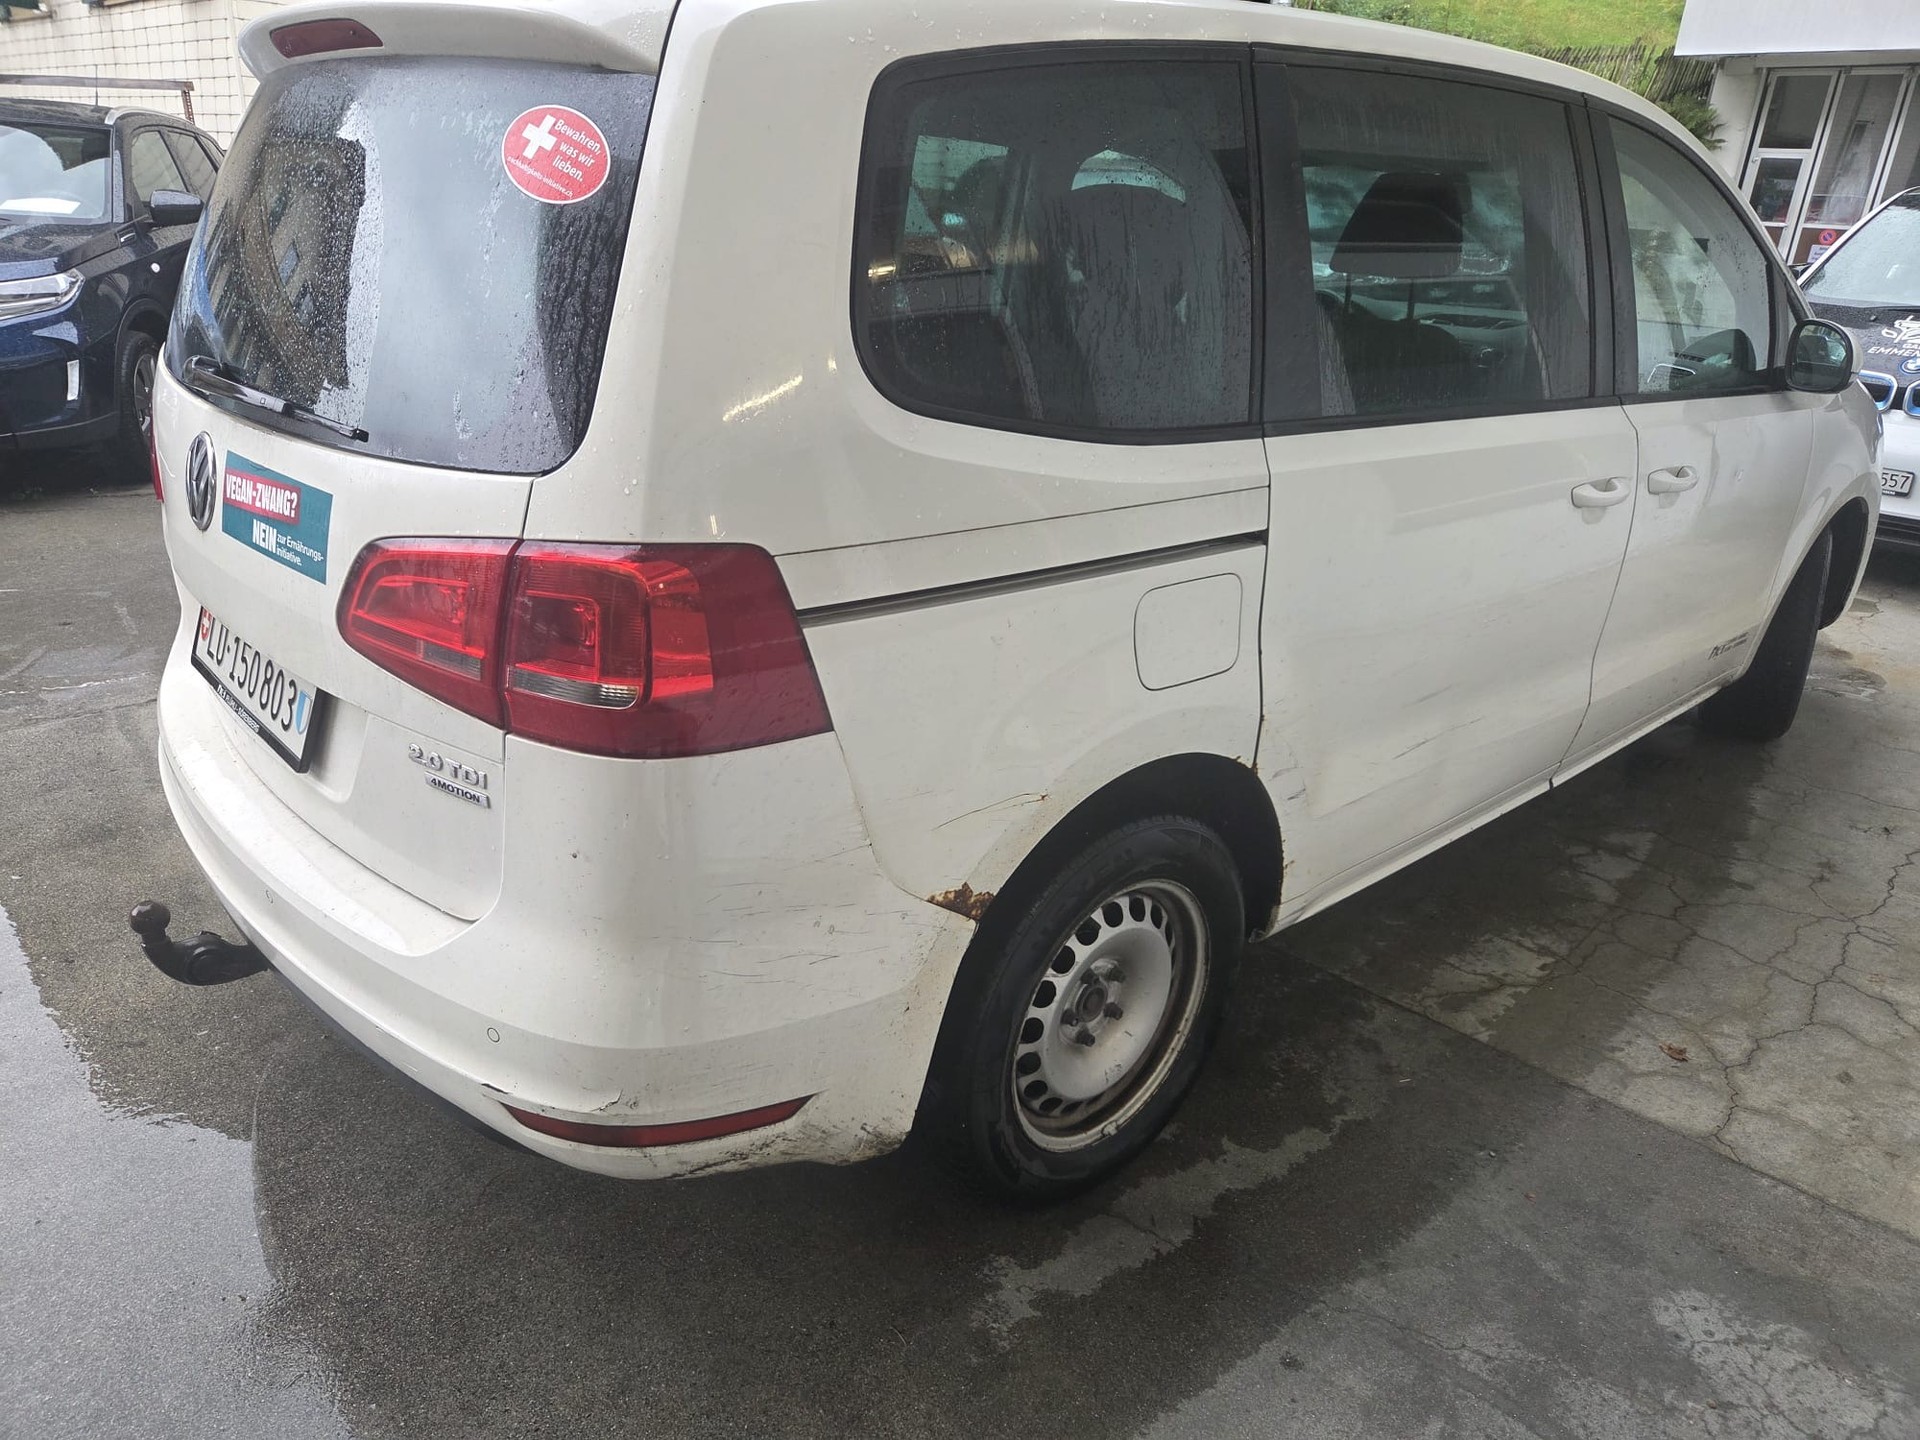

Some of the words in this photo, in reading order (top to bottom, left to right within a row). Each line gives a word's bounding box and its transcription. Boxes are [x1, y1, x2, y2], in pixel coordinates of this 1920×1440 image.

[554, 119, 601, 155] Bewahren,
[559, 142, 579, 158] was
[578, 153, 595, 167] wir
[552, 155, 584, 182] lieben.
[225, 473, 298, 518] VEGAN-ZWANG?
[252, 518, 277, 554] NEIN
[277, 533, 287, 545] zur
[286, 535, 325, 562] Ernährungs-
[408, 743, 444, 772] 2.0
[445, 758, 488, 790] TDI
[430, 778, 481, 804] 4MOTION
